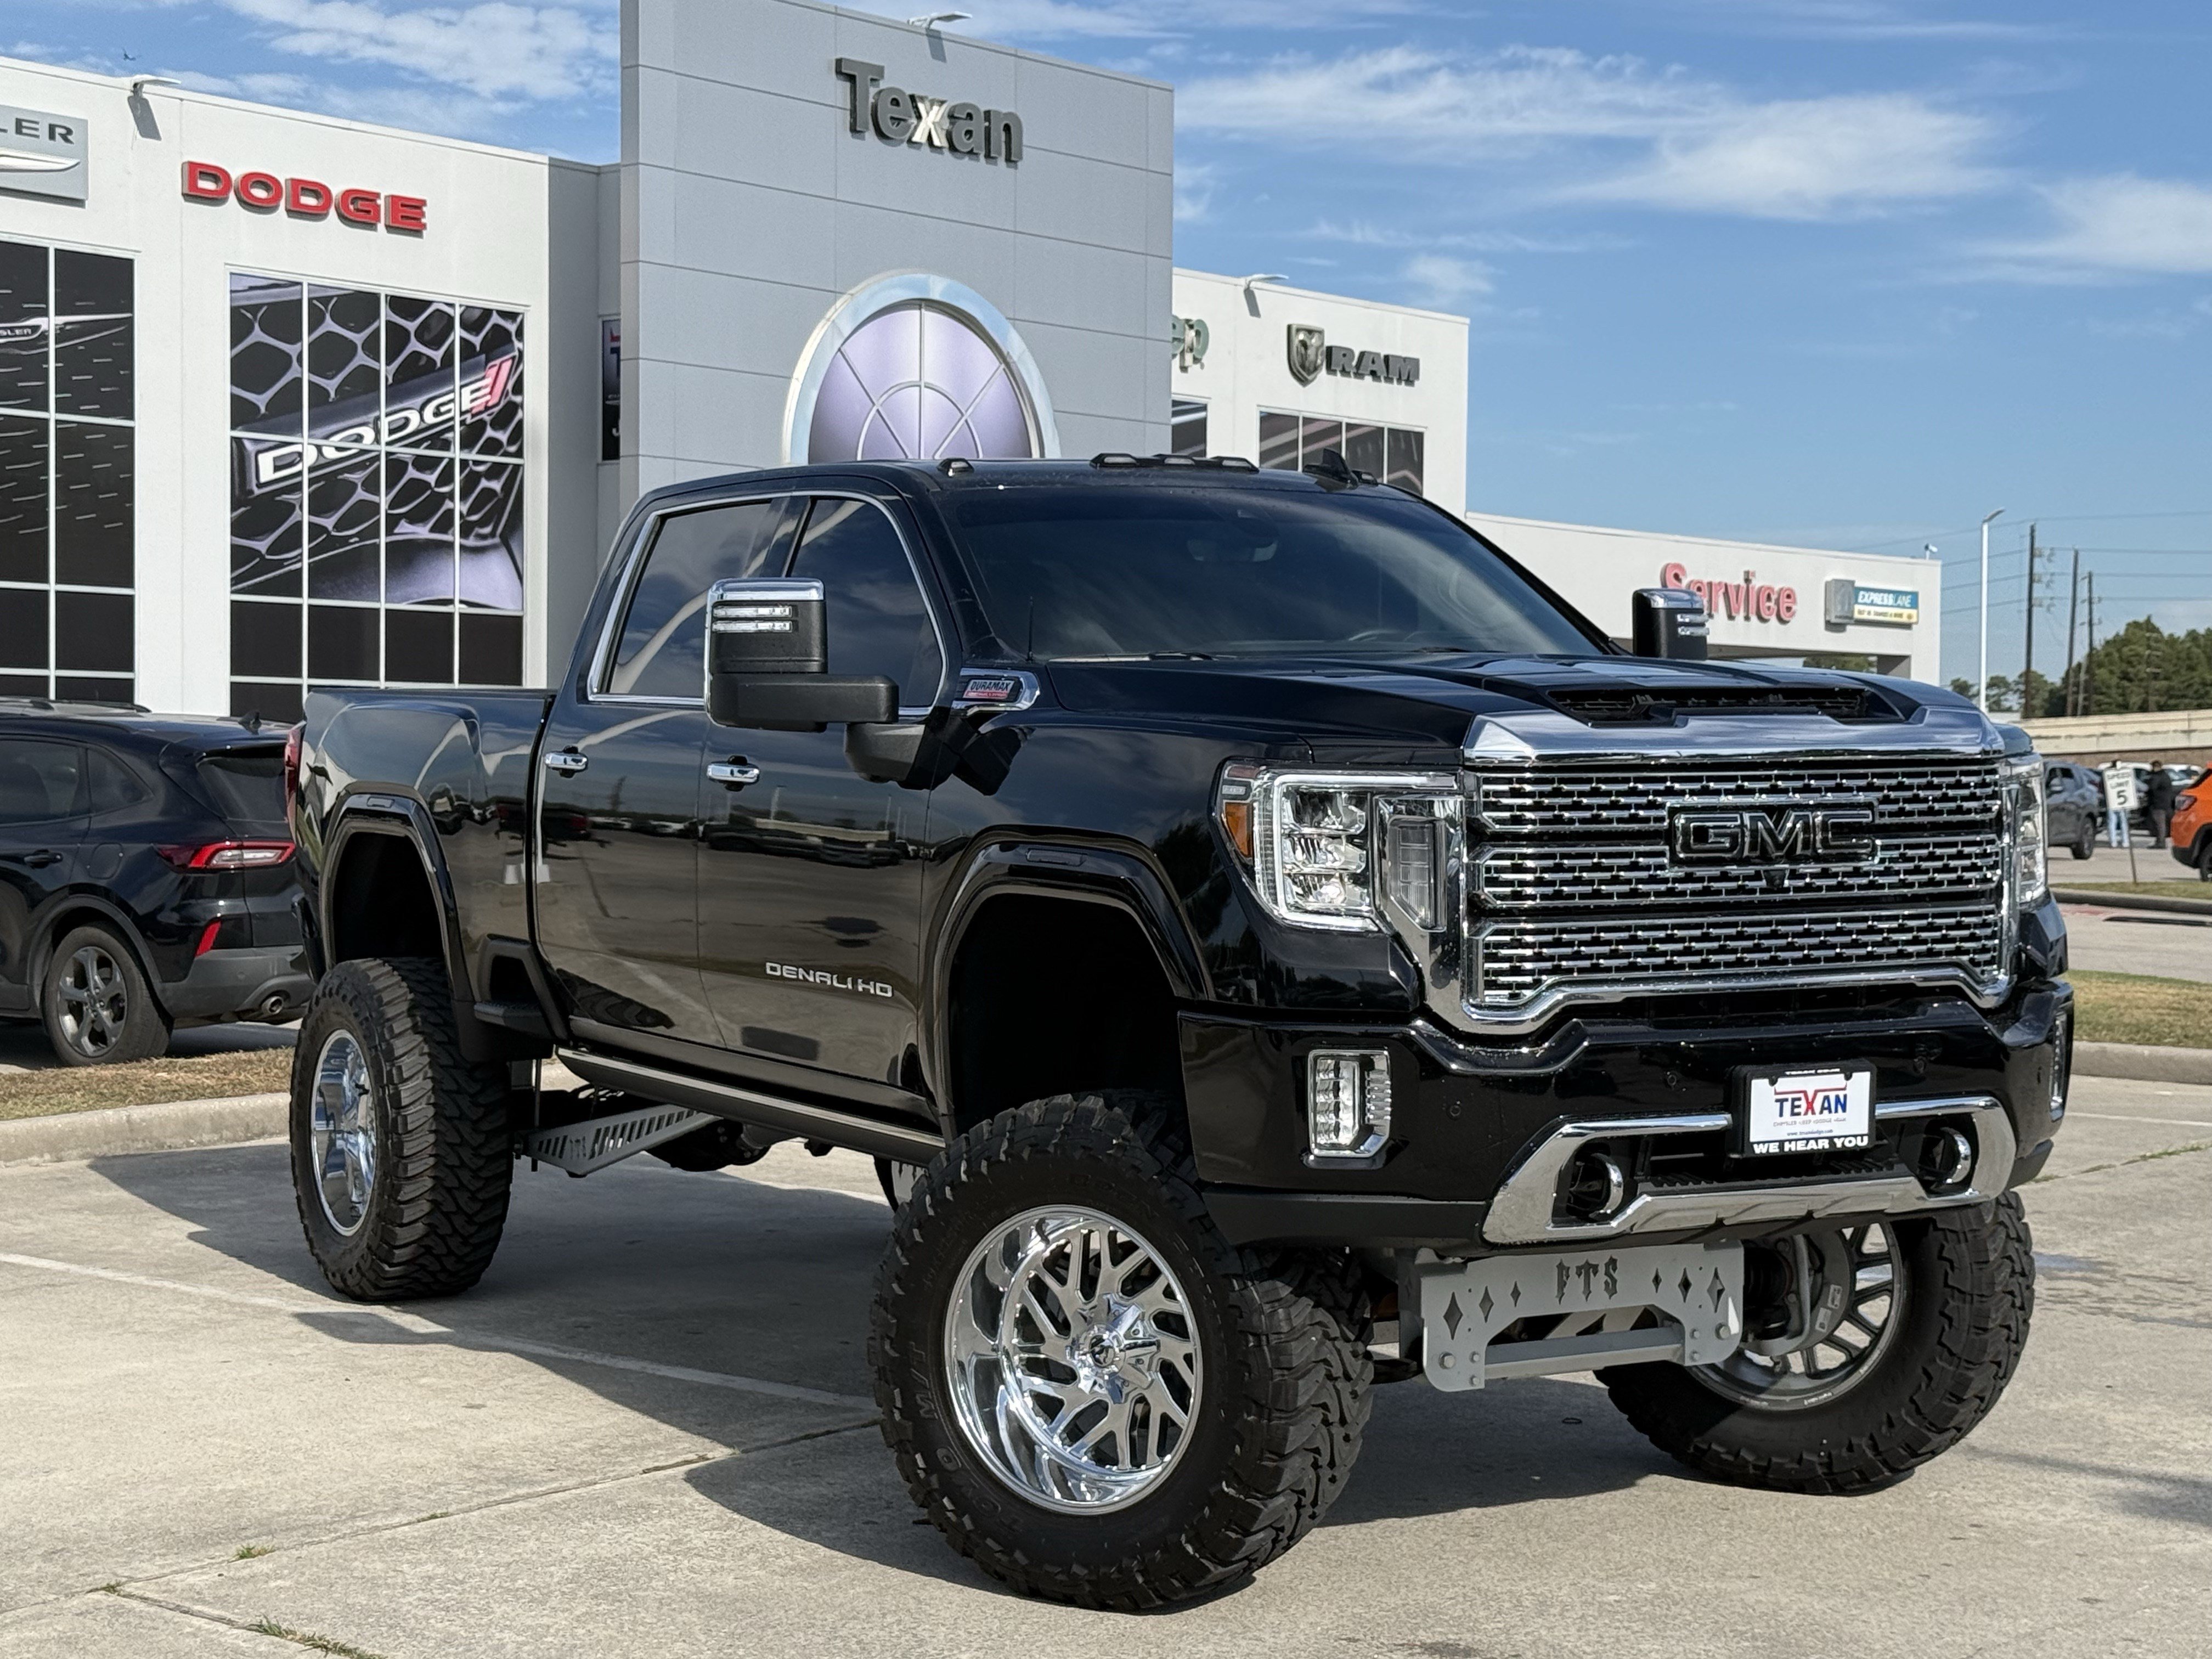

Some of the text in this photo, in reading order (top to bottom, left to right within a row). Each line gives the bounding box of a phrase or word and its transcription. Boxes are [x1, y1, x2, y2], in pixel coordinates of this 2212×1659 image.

[836, 58, 1023, 162] Texan
[182, 161, 427, 233] DODGE
[1326, 346, 1420, 381] RAM
[257, 376, 492, 484] DODGE
[970, 681, 1012, 692] DURAMAX
[2117, 789, 2128, 805] 5
[1674, 810, 1877, 861] GMC
[766, 962, 893, 997] DENALI HD
[1774, 1088, 1848, 1118] TEXAN
[1753, 1136, 1869, 1154] WE HEAR YOU
[1555, 1254, 1618, 1305] FTS
